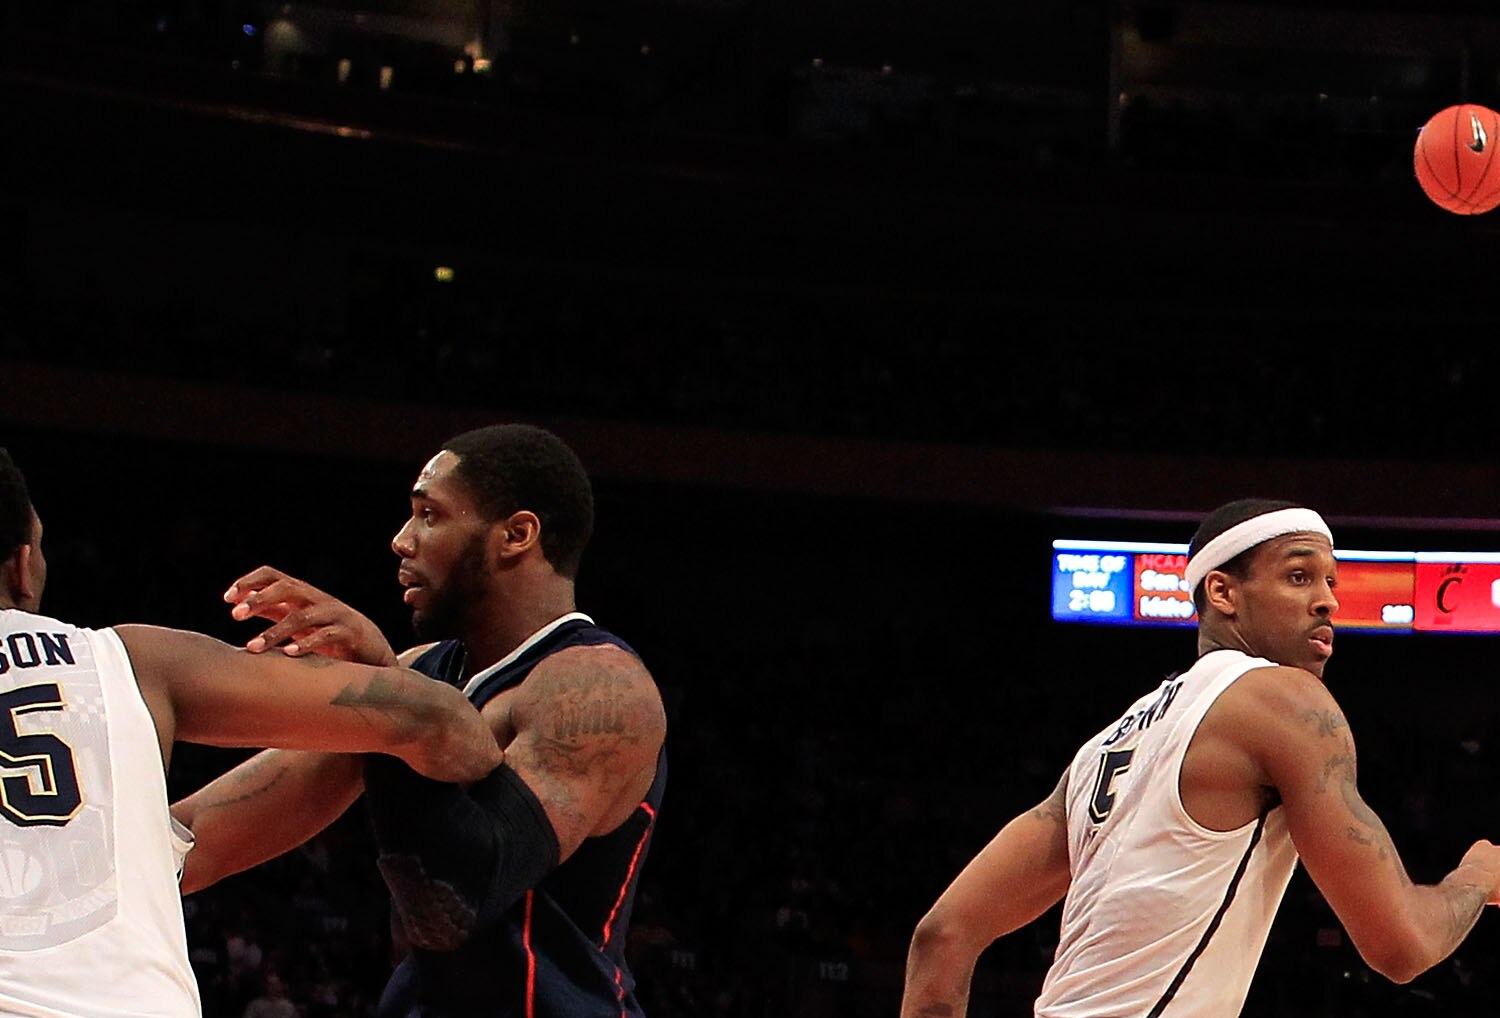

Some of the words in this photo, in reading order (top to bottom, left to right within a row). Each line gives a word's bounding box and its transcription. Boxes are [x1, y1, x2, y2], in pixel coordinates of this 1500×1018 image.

[1057, 554, 1099, 573] TIME
[1143, 554, 1188, 570] NCAA
[0, 632, 76, 675] ON
[0, 681, 87, 828] 5
